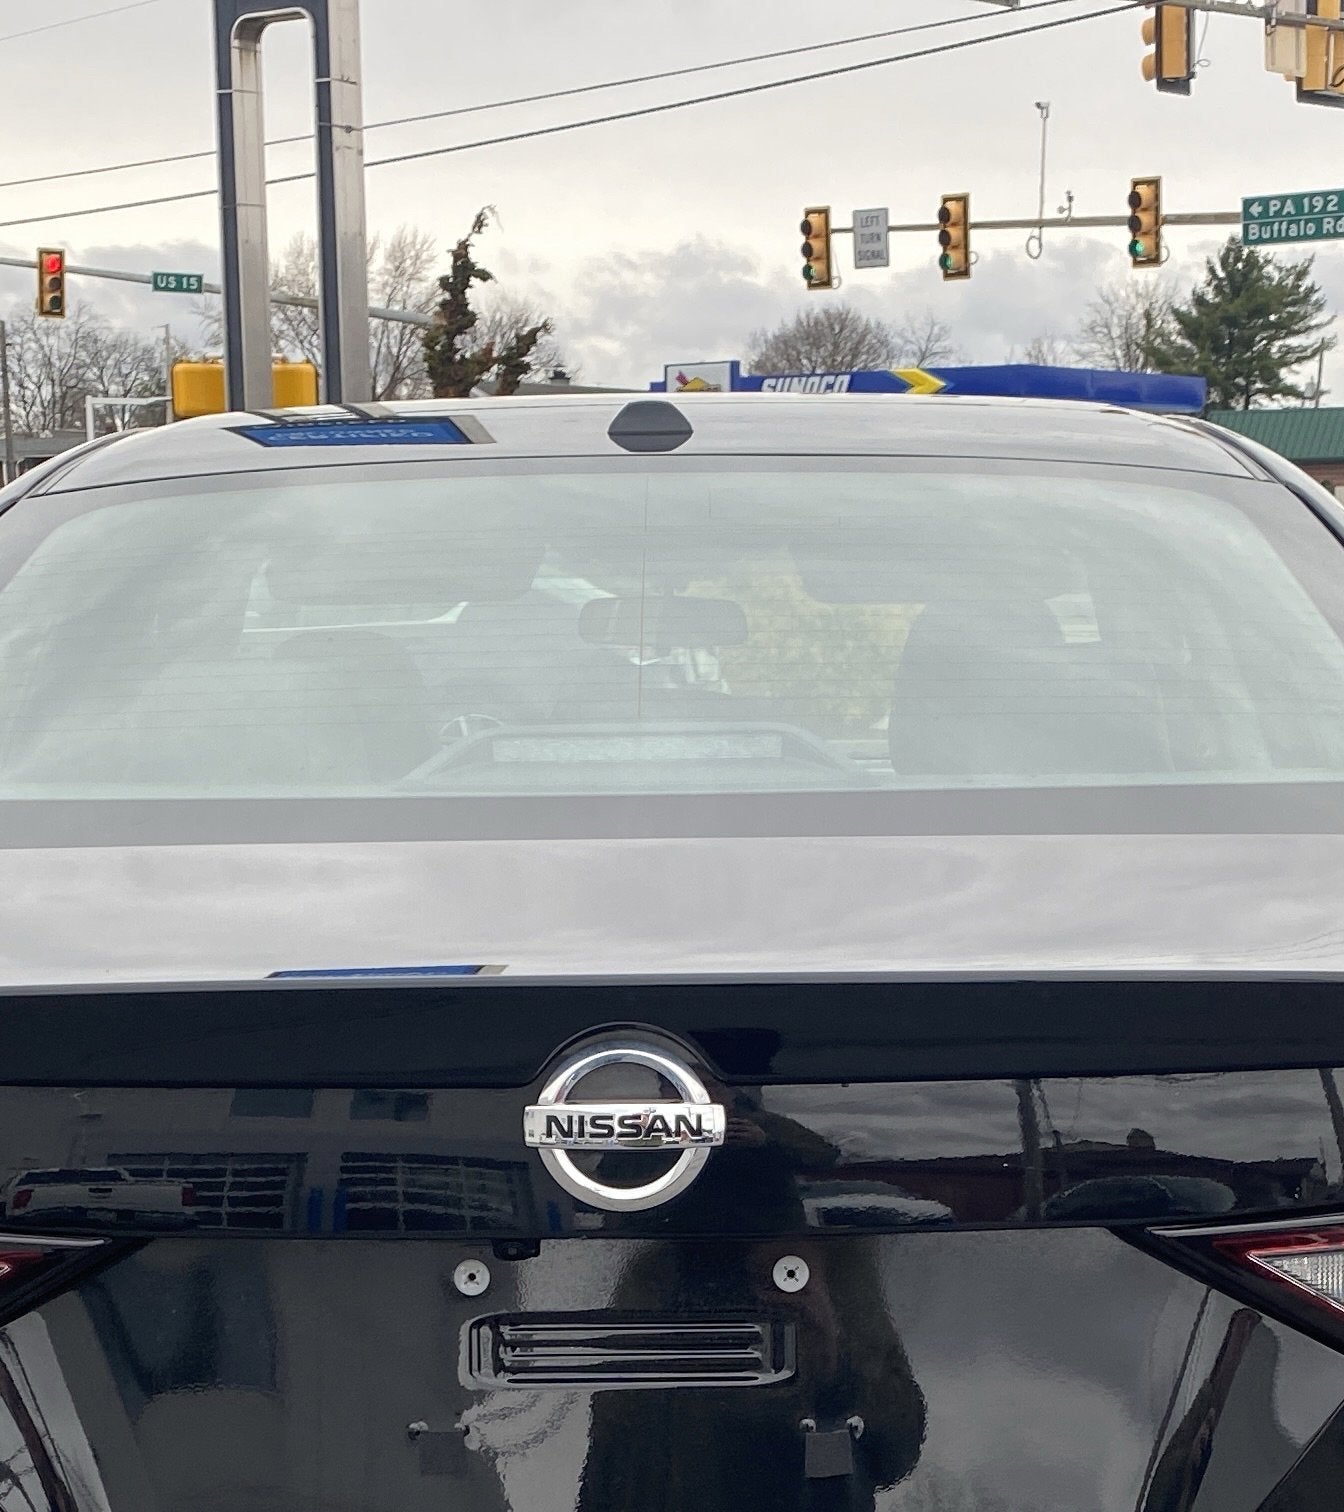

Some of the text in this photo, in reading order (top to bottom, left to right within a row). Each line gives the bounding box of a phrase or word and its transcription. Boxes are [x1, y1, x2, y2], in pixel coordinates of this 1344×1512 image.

[1268, 194, 1339, 217] PA 192
[1247, 218, 1316, 241] Buffalo
[157, 275, 198, 289] US 15
[761, 374, 852, 394] SUNOCO
[545, 1114, 703, 1139] NISSAN
